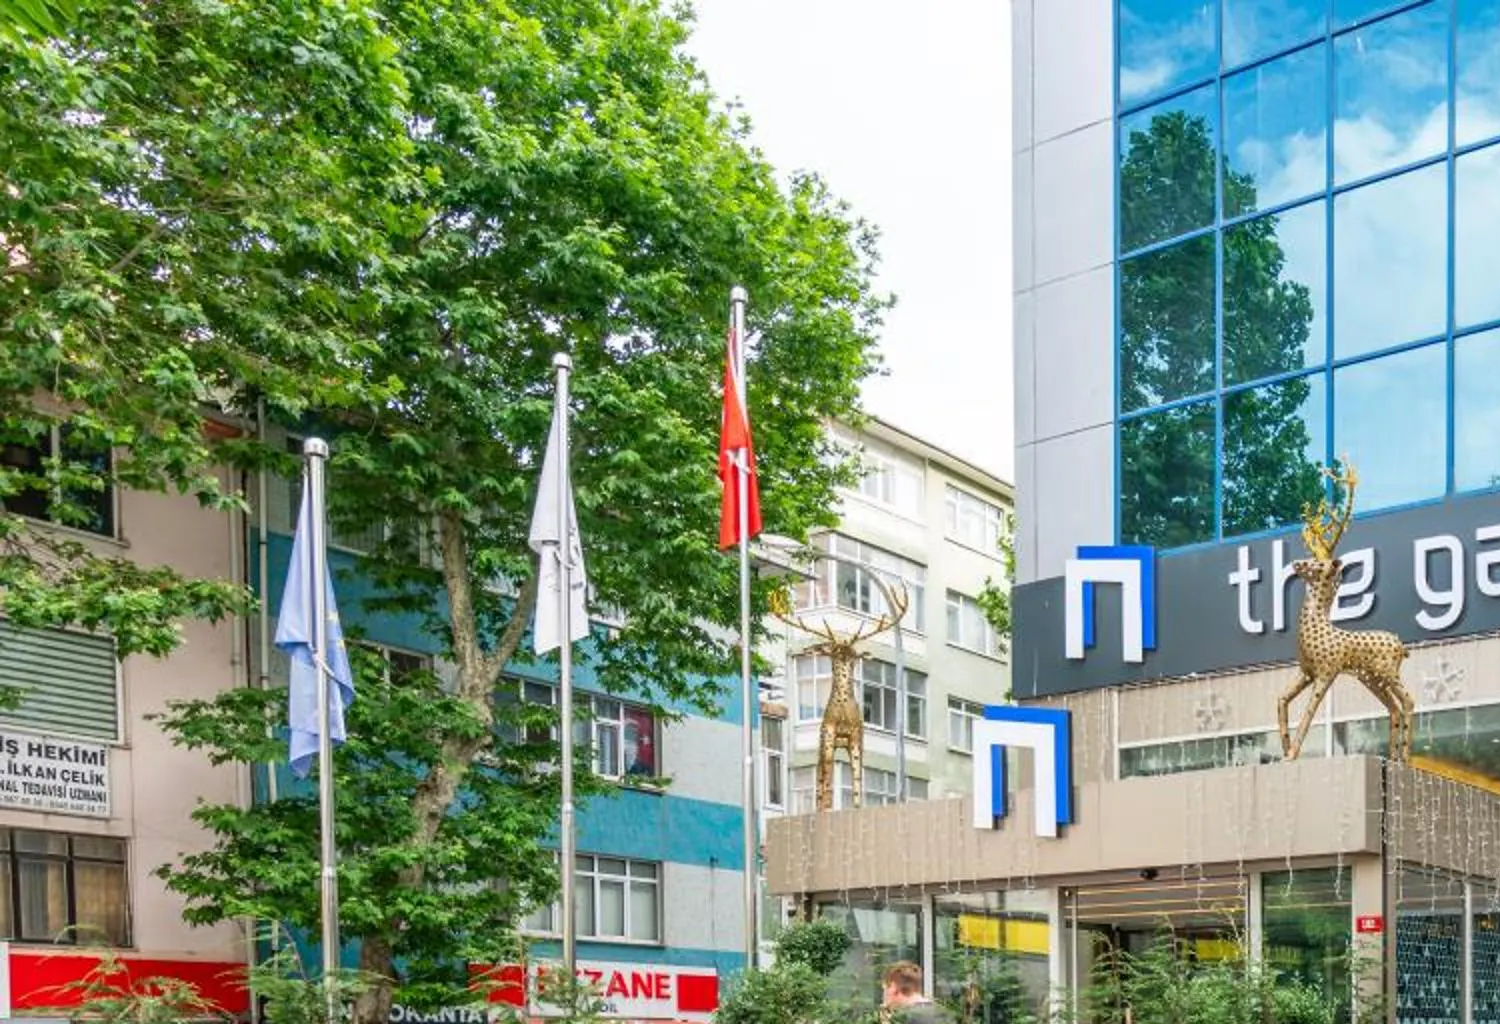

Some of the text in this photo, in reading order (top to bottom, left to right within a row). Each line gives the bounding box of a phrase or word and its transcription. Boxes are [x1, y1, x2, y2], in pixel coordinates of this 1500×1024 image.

[1228, 539, 1377, 635] the
[27, 742, 105, 767] HEKİMİ
[7, 760, 105, 787] İLKAN ÇELİK
